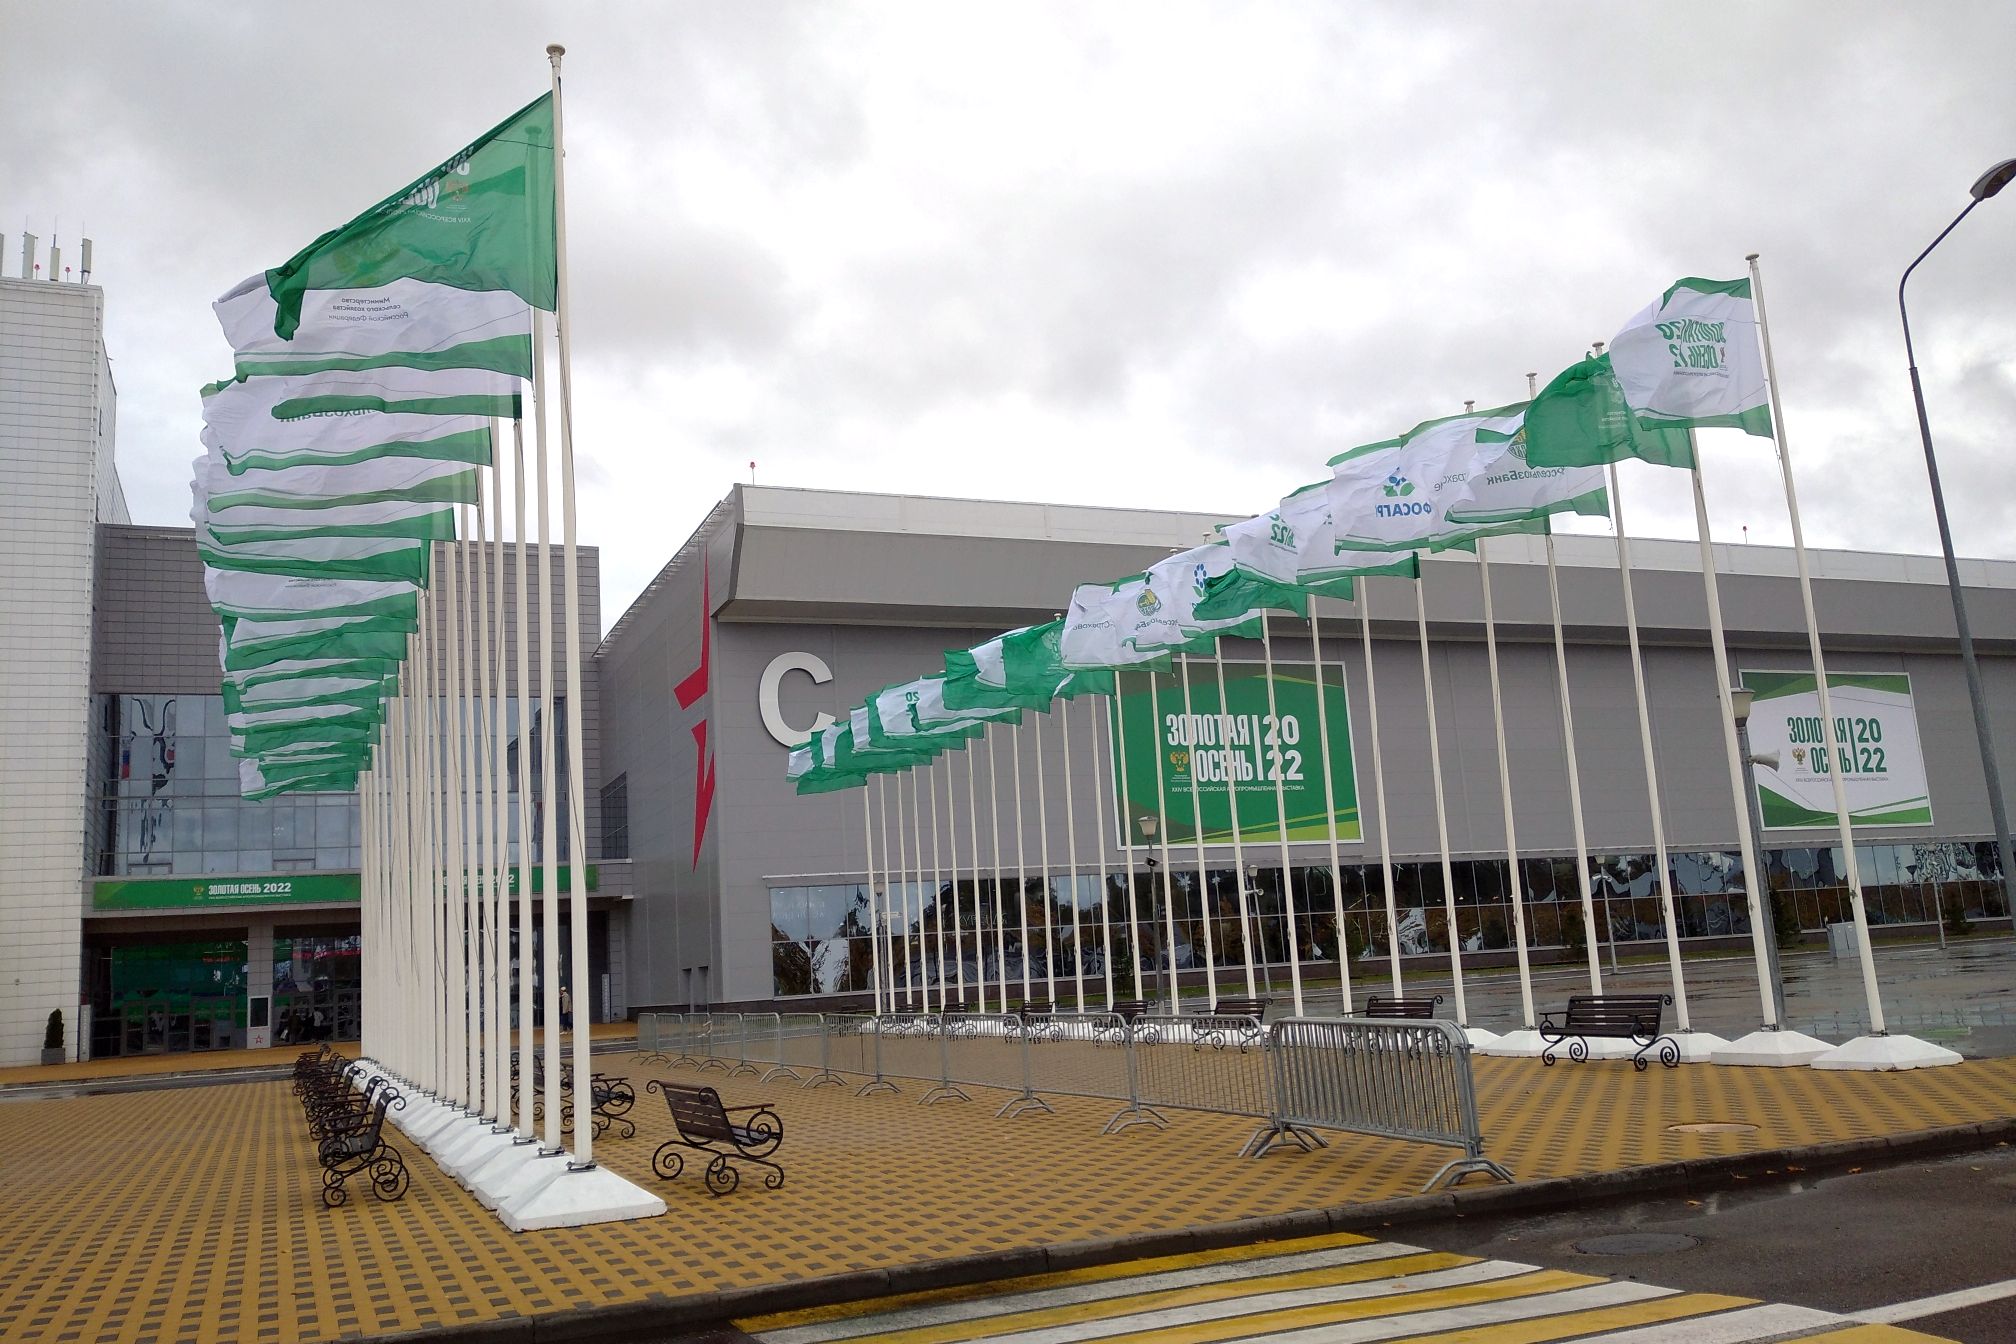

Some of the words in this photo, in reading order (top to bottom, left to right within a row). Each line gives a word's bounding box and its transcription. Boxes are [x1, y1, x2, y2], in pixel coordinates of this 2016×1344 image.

[1165, 713, 1251, 746] ЗОЛОТАЯ
[1262, 714, 1300, 746] 20
[1855, 717, 1882, 743] 20
[1195, 749, 1254, 782] ОСЕНЬ
[1265, 749, 1304, 780] 22
[1860, 747, 1888, 773] 22
[208, 884, 239, 895] ЗОЛОТАЯ
[240, 883, 261, 894] ОСЕНЬ
[263, 882, 291, 893] 2022
